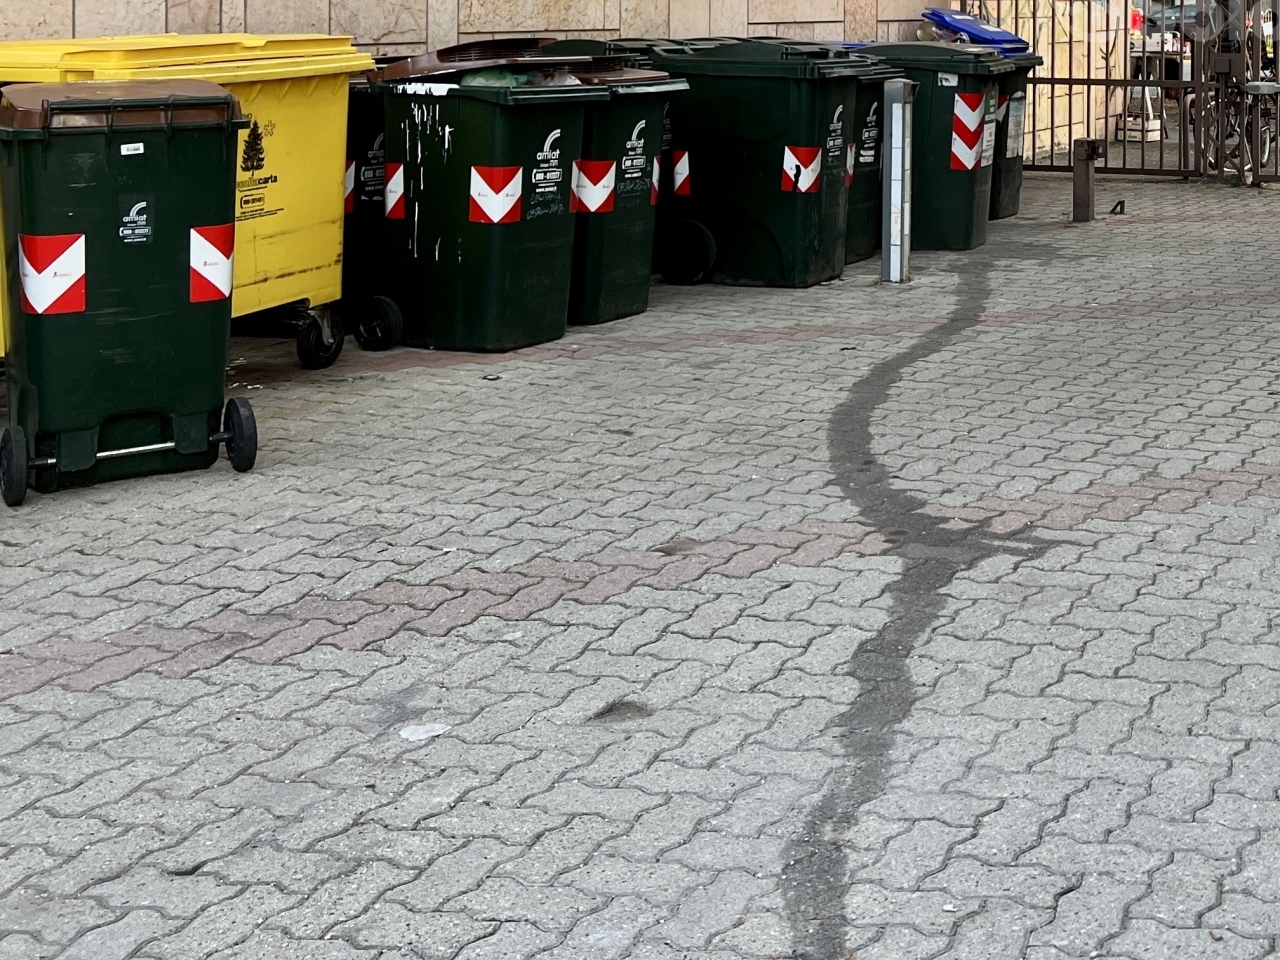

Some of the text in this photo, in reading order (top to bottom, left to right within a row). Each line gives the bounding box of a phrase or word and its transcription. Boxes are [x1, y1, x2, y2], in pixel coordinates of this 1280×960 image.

[626, 138, 644, 149] amiat
[536, 148, 561, 161] amiat
[122, 214, 147, 222] amiat
